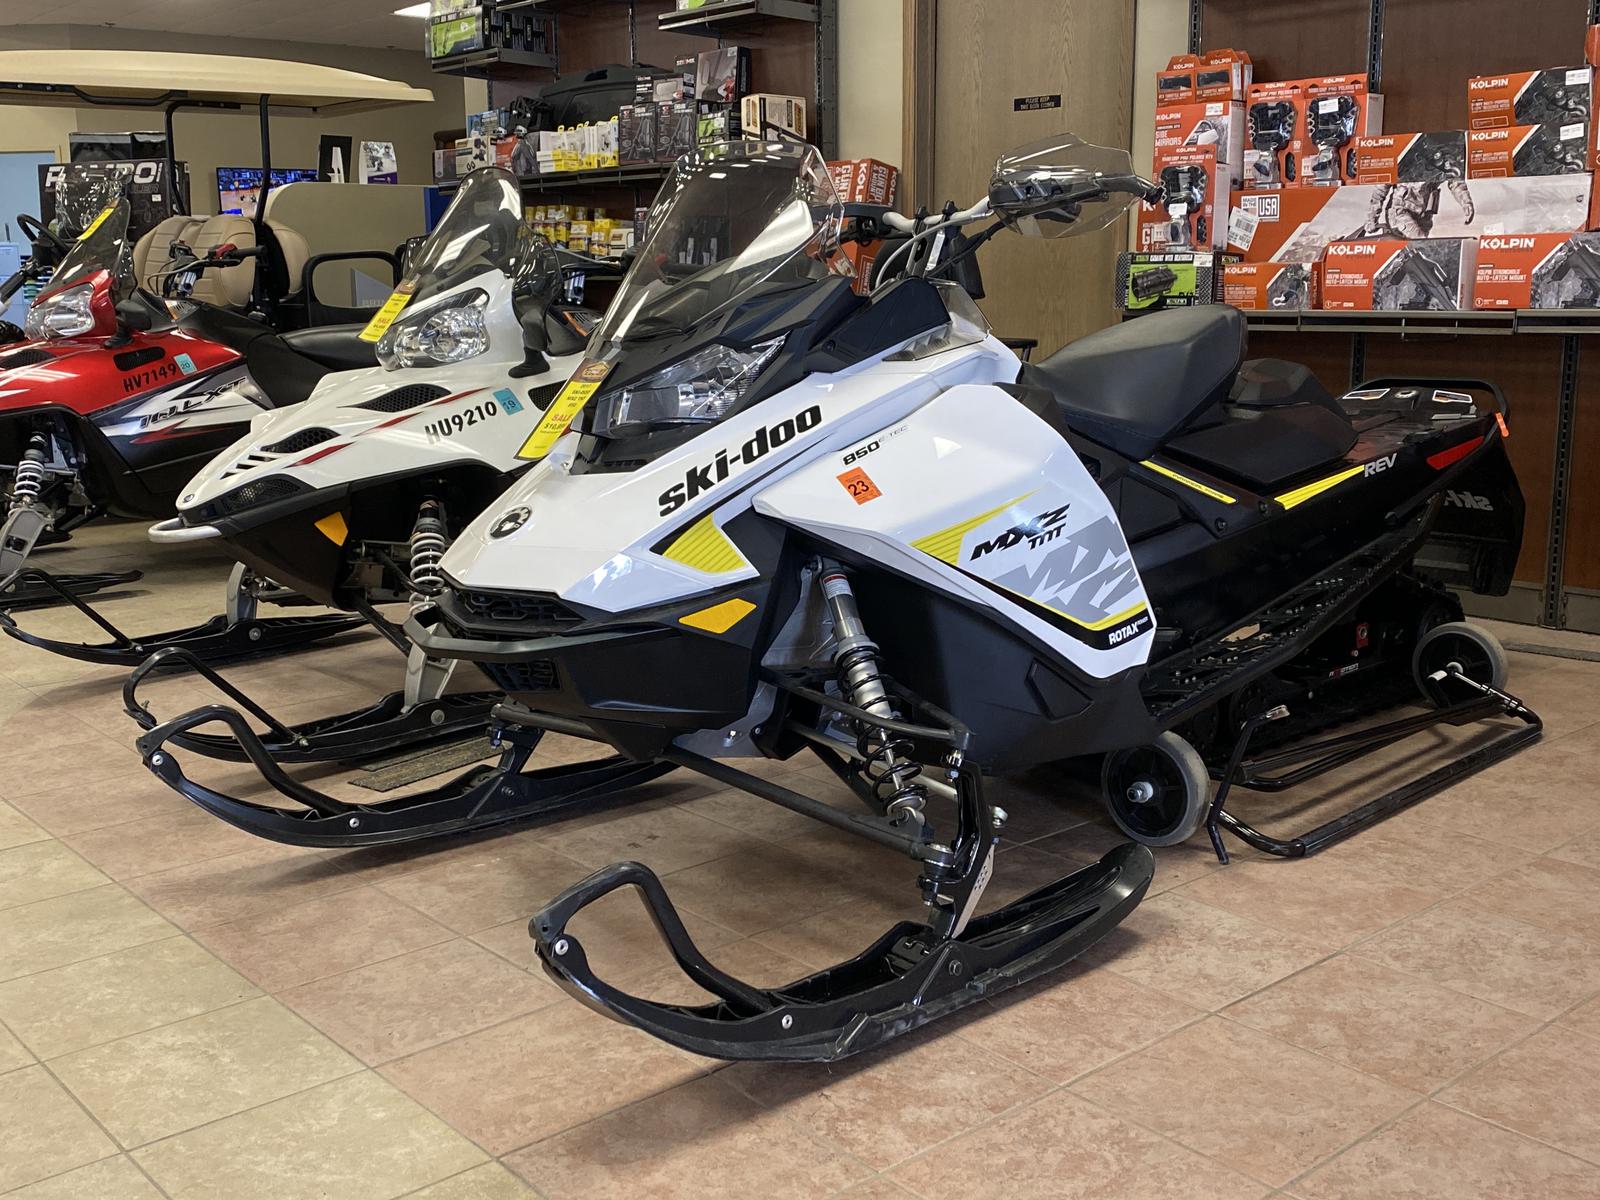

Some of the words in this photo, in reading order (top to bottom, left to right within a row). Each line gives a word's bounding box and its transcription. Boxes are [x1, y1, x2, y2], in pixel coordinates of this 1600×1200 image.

[1471, 78, 1509, 90] KOLPIN
[1156, 112, 1181, 121] KOLPIN
[1154, 136, 1182, 146] MIRRORS
[1471, 131, 1509, 141] KOLPIN
[1360, 138, 1394, 148] KOLPIN
[855, 163, 867, 203] KOLP
[1259, 197, 1277, 216] USA
[1328, 244, 1376, 256] KOLPIN
[1480, 238, 1536, 250] KOLPIN
[1224, 266, 1257, 275] KOLPIN
[180, 362, 190, 370] 20
[123, 362, 177, 393] HV7149
[502, 399, 515, 410] 19
[424, 401, 498, 445] HU9210
[842, 440, 880, 466] 850
[658, 404, 823, 518] ski-doo
[1364, 453, 1397, 478] REV
[847, 480, 870, 497] 23
[1108, 622, 1139, 645] ROTAX
